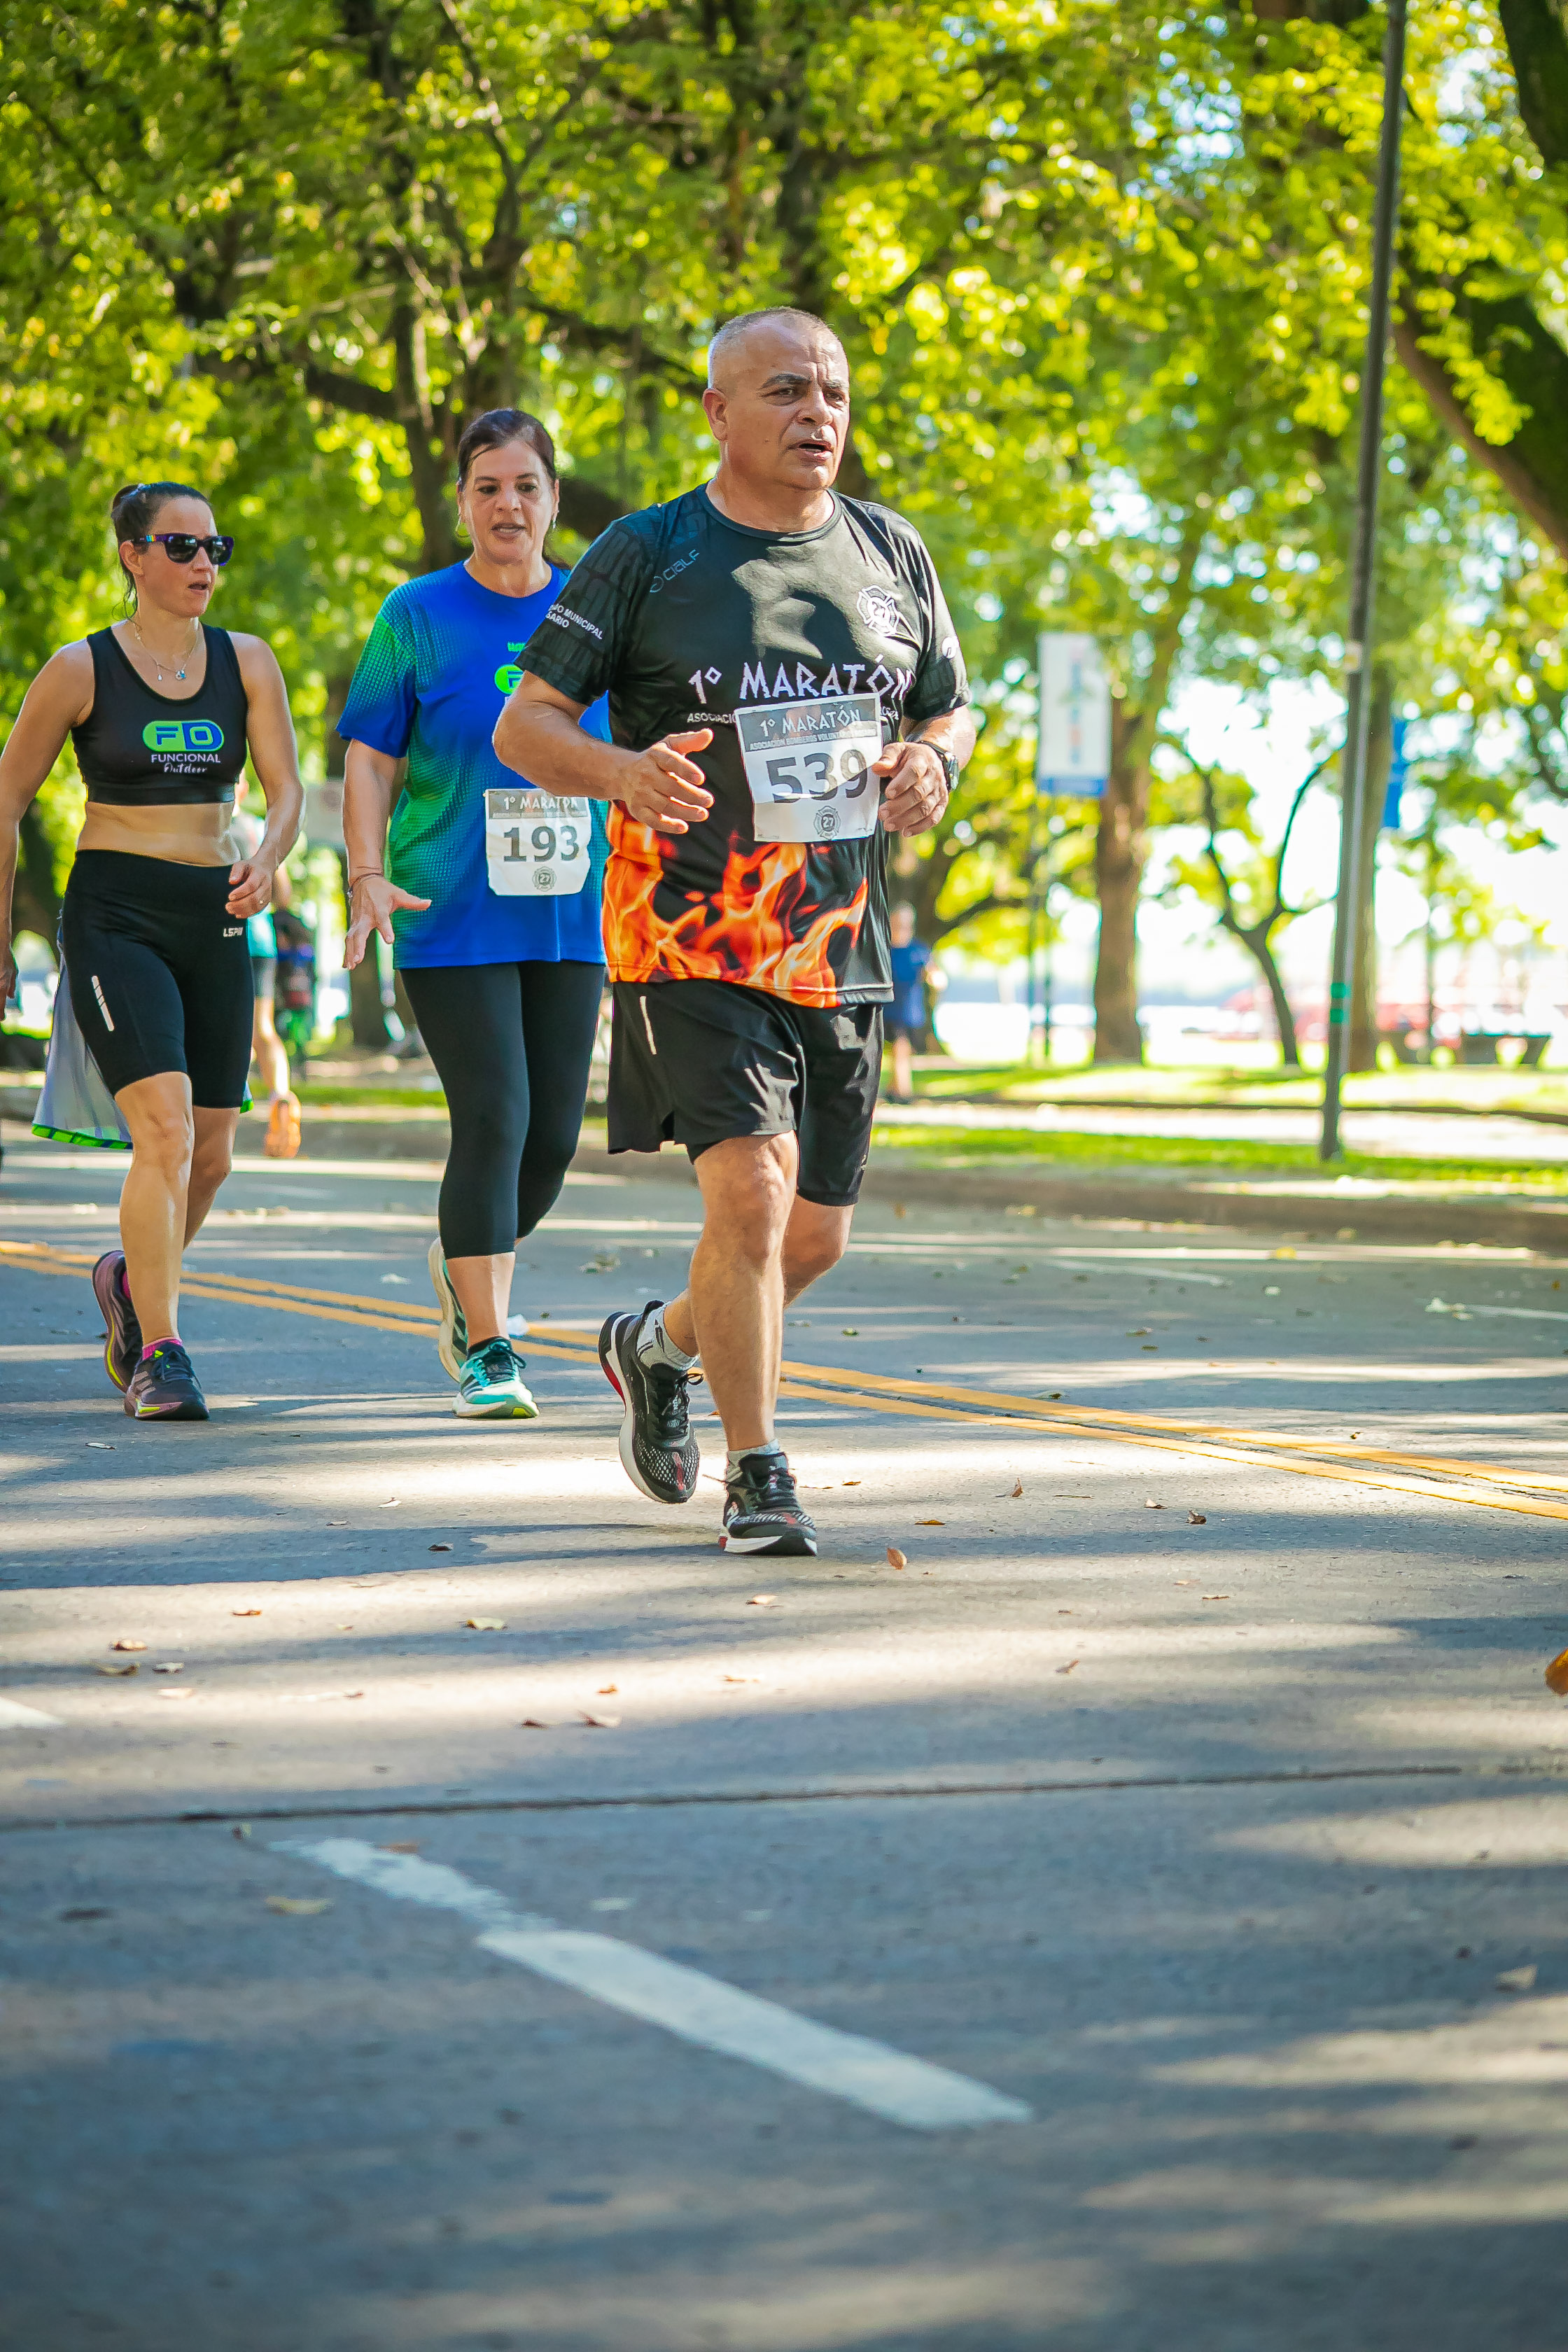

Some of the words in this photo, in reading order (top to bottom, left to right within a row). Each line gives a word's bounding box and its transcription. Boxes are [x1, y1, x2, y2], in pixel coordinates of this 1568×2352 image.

[564, 608, 603, 640] MUNICIPAL
[739, 654, 913, 701] MARATÓN
[782, 705, 861, 734] MARATÓN
[150, 753, 221, 763] FUNCIONAL
[164, 762, 208, 774] Outdoor
[766, 750, 868, 804] 539
[822, 816, 834, 829] 27
[503, 826, 580, 862] 193
[539, 874, 551, 883] 27
